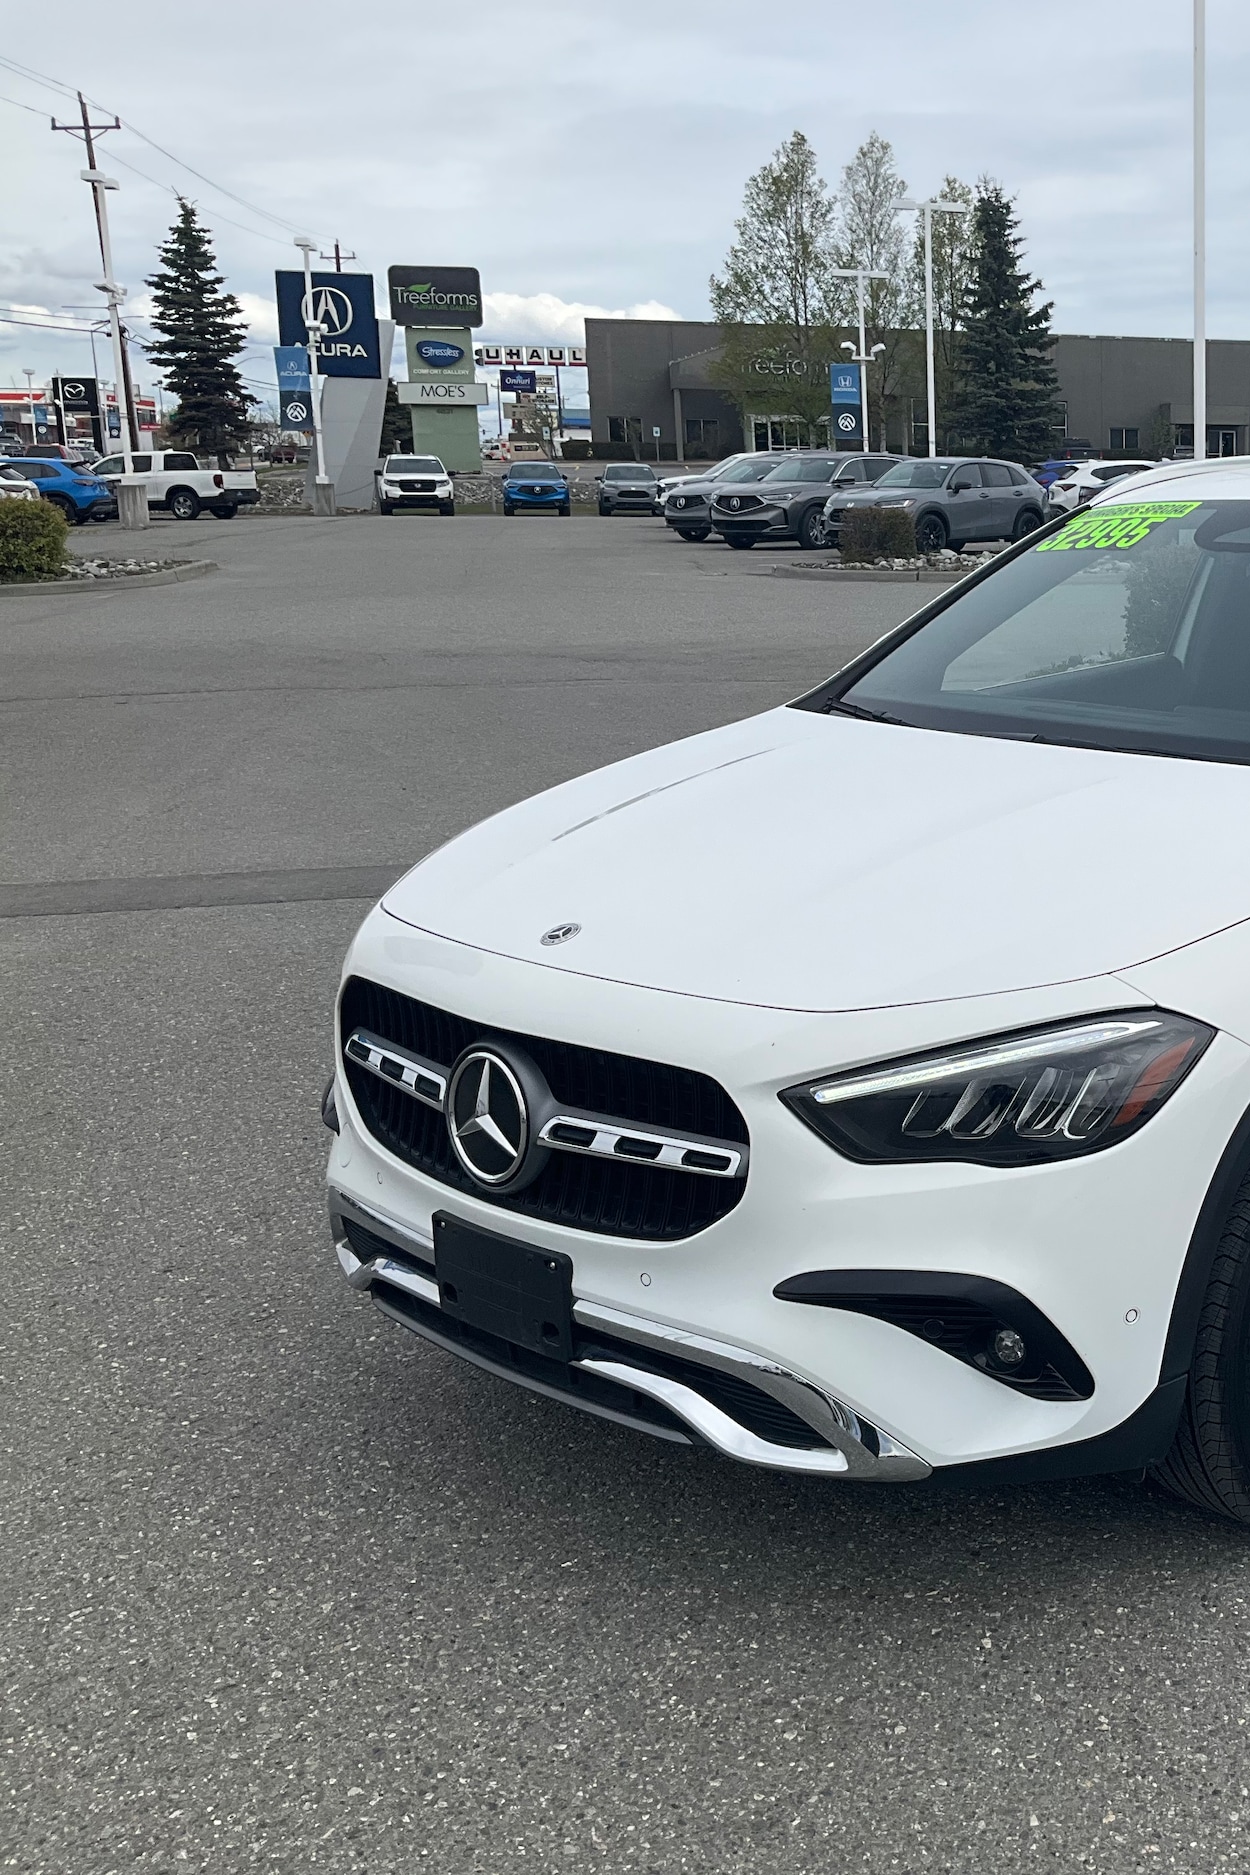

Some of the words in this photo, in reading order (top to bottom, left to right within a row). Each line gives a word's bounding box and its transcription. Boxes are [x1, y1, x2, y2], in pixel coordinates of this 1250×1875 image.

[392, 286, 478, 306] Treeforms
[294, 341, 368, 357] CURA
[422, 346, 460, 358] Stressless
[420, 384, 466, 398] MOE'S
[1036, 516, 1168, 552] 32995
